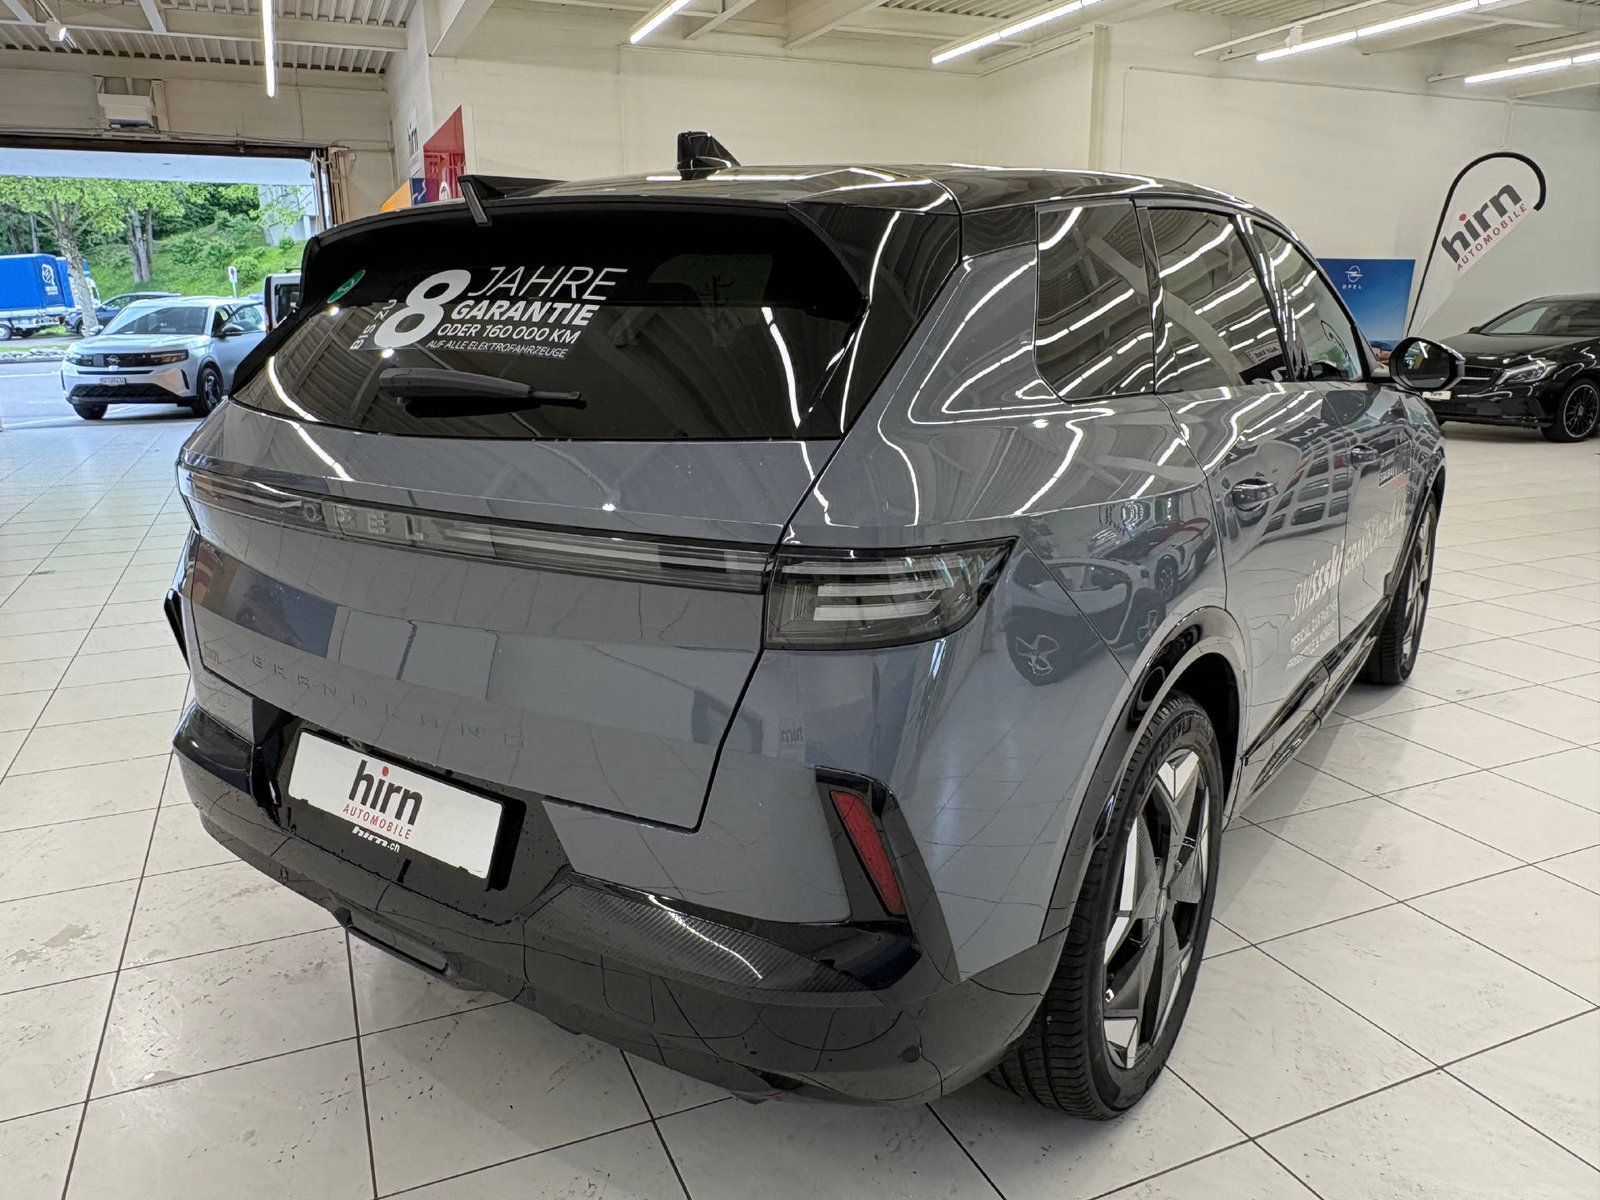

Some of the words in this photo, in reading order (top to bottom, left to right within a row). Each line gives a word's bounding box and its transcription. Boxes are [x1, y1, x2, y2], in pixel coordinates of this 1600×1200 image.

[1441, 184, 1523, 264] hirn
[1456, 203, 1527, 271] AUTOMOBILE
[467, 265, 628, 301] JAHRE
[349, 323, 377, 350] BIS
[373, 299, 398, 320] ZU
[373, 269, 472, 348] 8
[451, 300, 600, 326] GARANTIE
[426, 340, 446, 349] AUF
[446, 341, 468, 350] ALLE
[467, 341, 569, 358] ELEKTROFAHRZEUGE
[437, 323, 481, 337] ODER
[482, 324, 511, 338] 160
[512, 326, 550, 342] 000
[548, 329, 582, 345] KM
[348, 759, 423, 826] hirn
[343, 803, 412, 840] AUTOMOBILE
